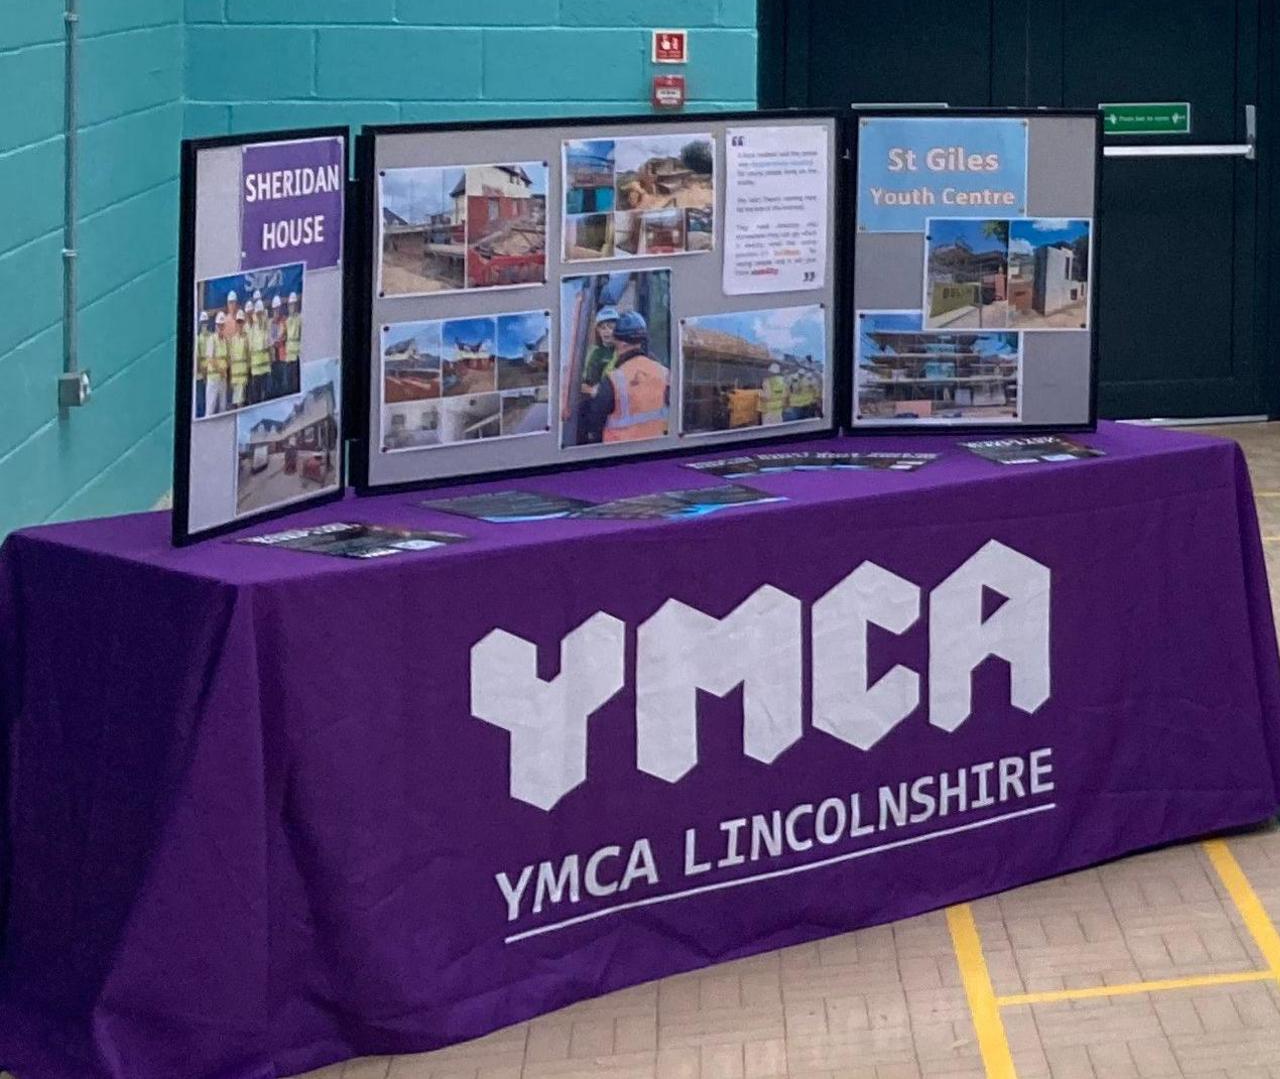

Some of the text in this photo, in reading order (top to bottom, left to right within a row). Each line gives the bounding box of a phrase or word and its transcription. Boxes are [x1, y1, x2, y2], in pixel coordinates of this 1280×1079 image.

[887, 146, 999, 172] St Giles
[244, 164, 340, 203] SHERIDAN
[870, 186, 1016, 206] Youth Centre
[261, 215, 326, 251] HOUSE
[471, 540, 1052, 811] YMCA
[494, 747, 1056, 922] YMCA LINCOLNSHIRE
